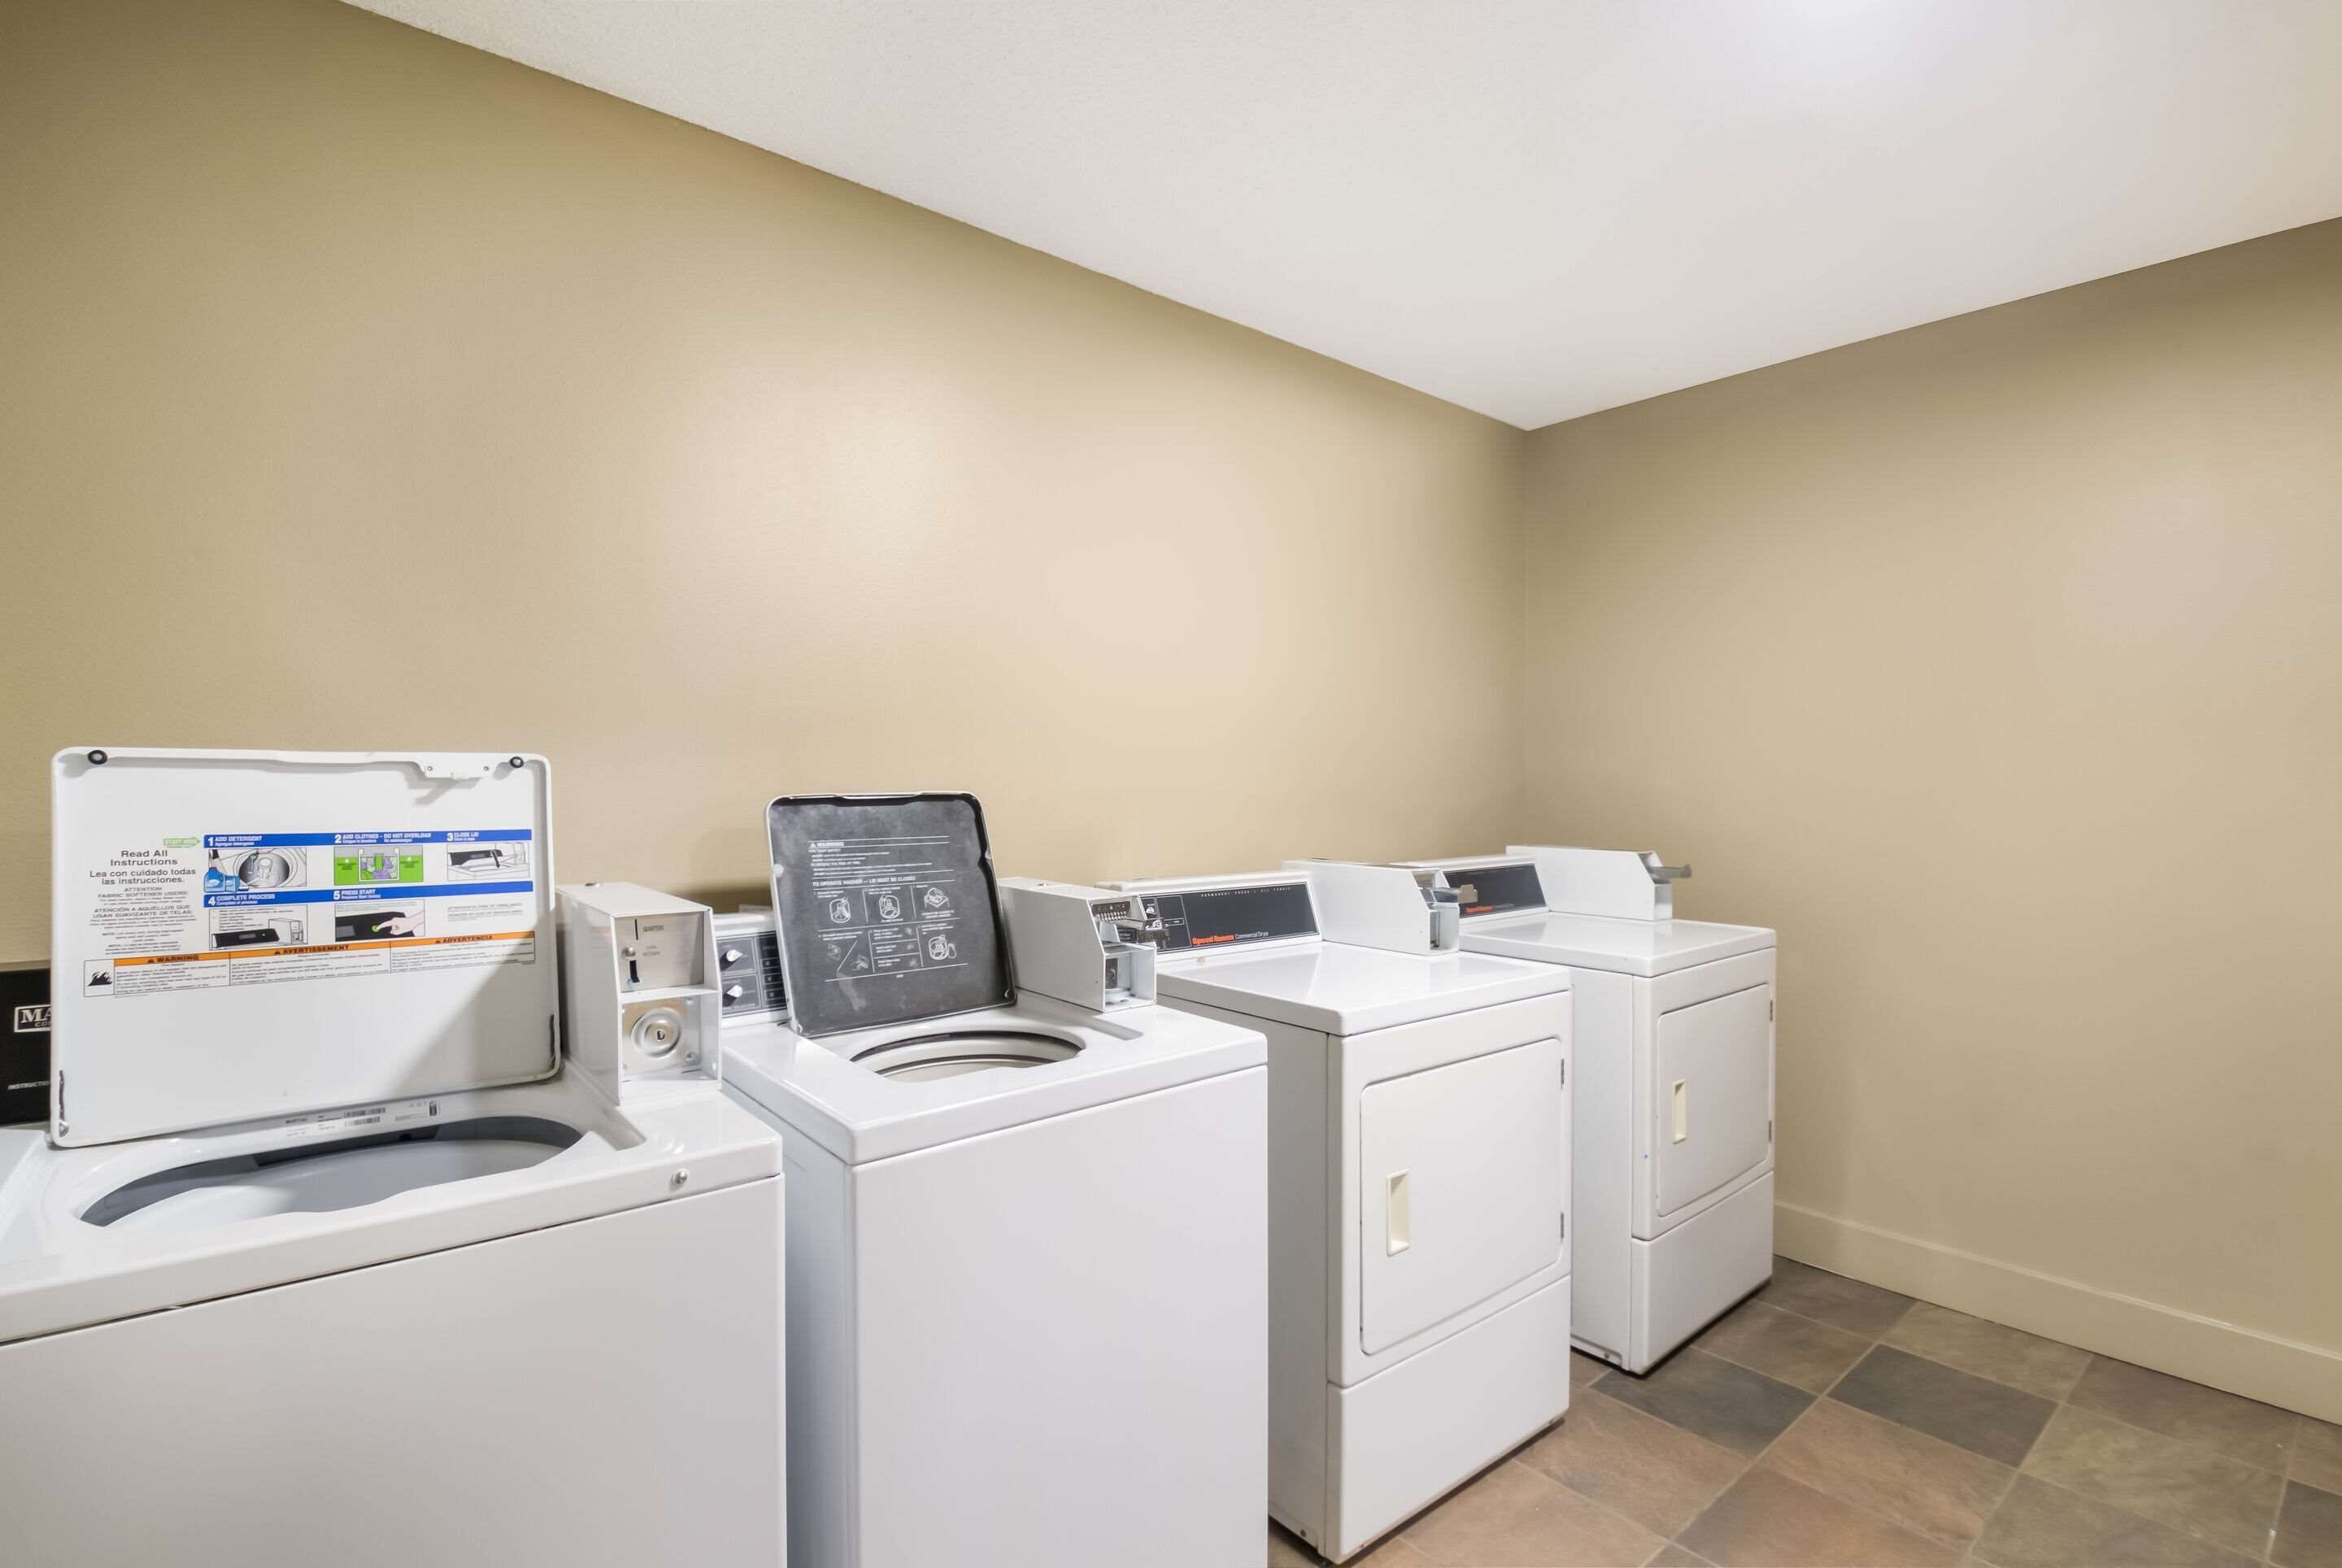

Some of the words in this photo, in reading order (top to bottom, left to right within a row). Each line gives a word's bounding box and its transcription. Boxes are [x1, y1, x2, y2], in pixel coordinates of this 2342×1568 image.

[334, 834, 342, 843] 2
[447, 833, 454, 841] 3
[207, 837, 214, 846] 1
[111, 858, 178, 866] Instructions
[333, 891, 340, 899] 5
[207, 896, 215, 906] 4
[442, 935, 493, 943] ADVERTENCIA
[283, 944, 350, 954] AVERTISSEMENT
[157, 955, 200, 963] WARNING
